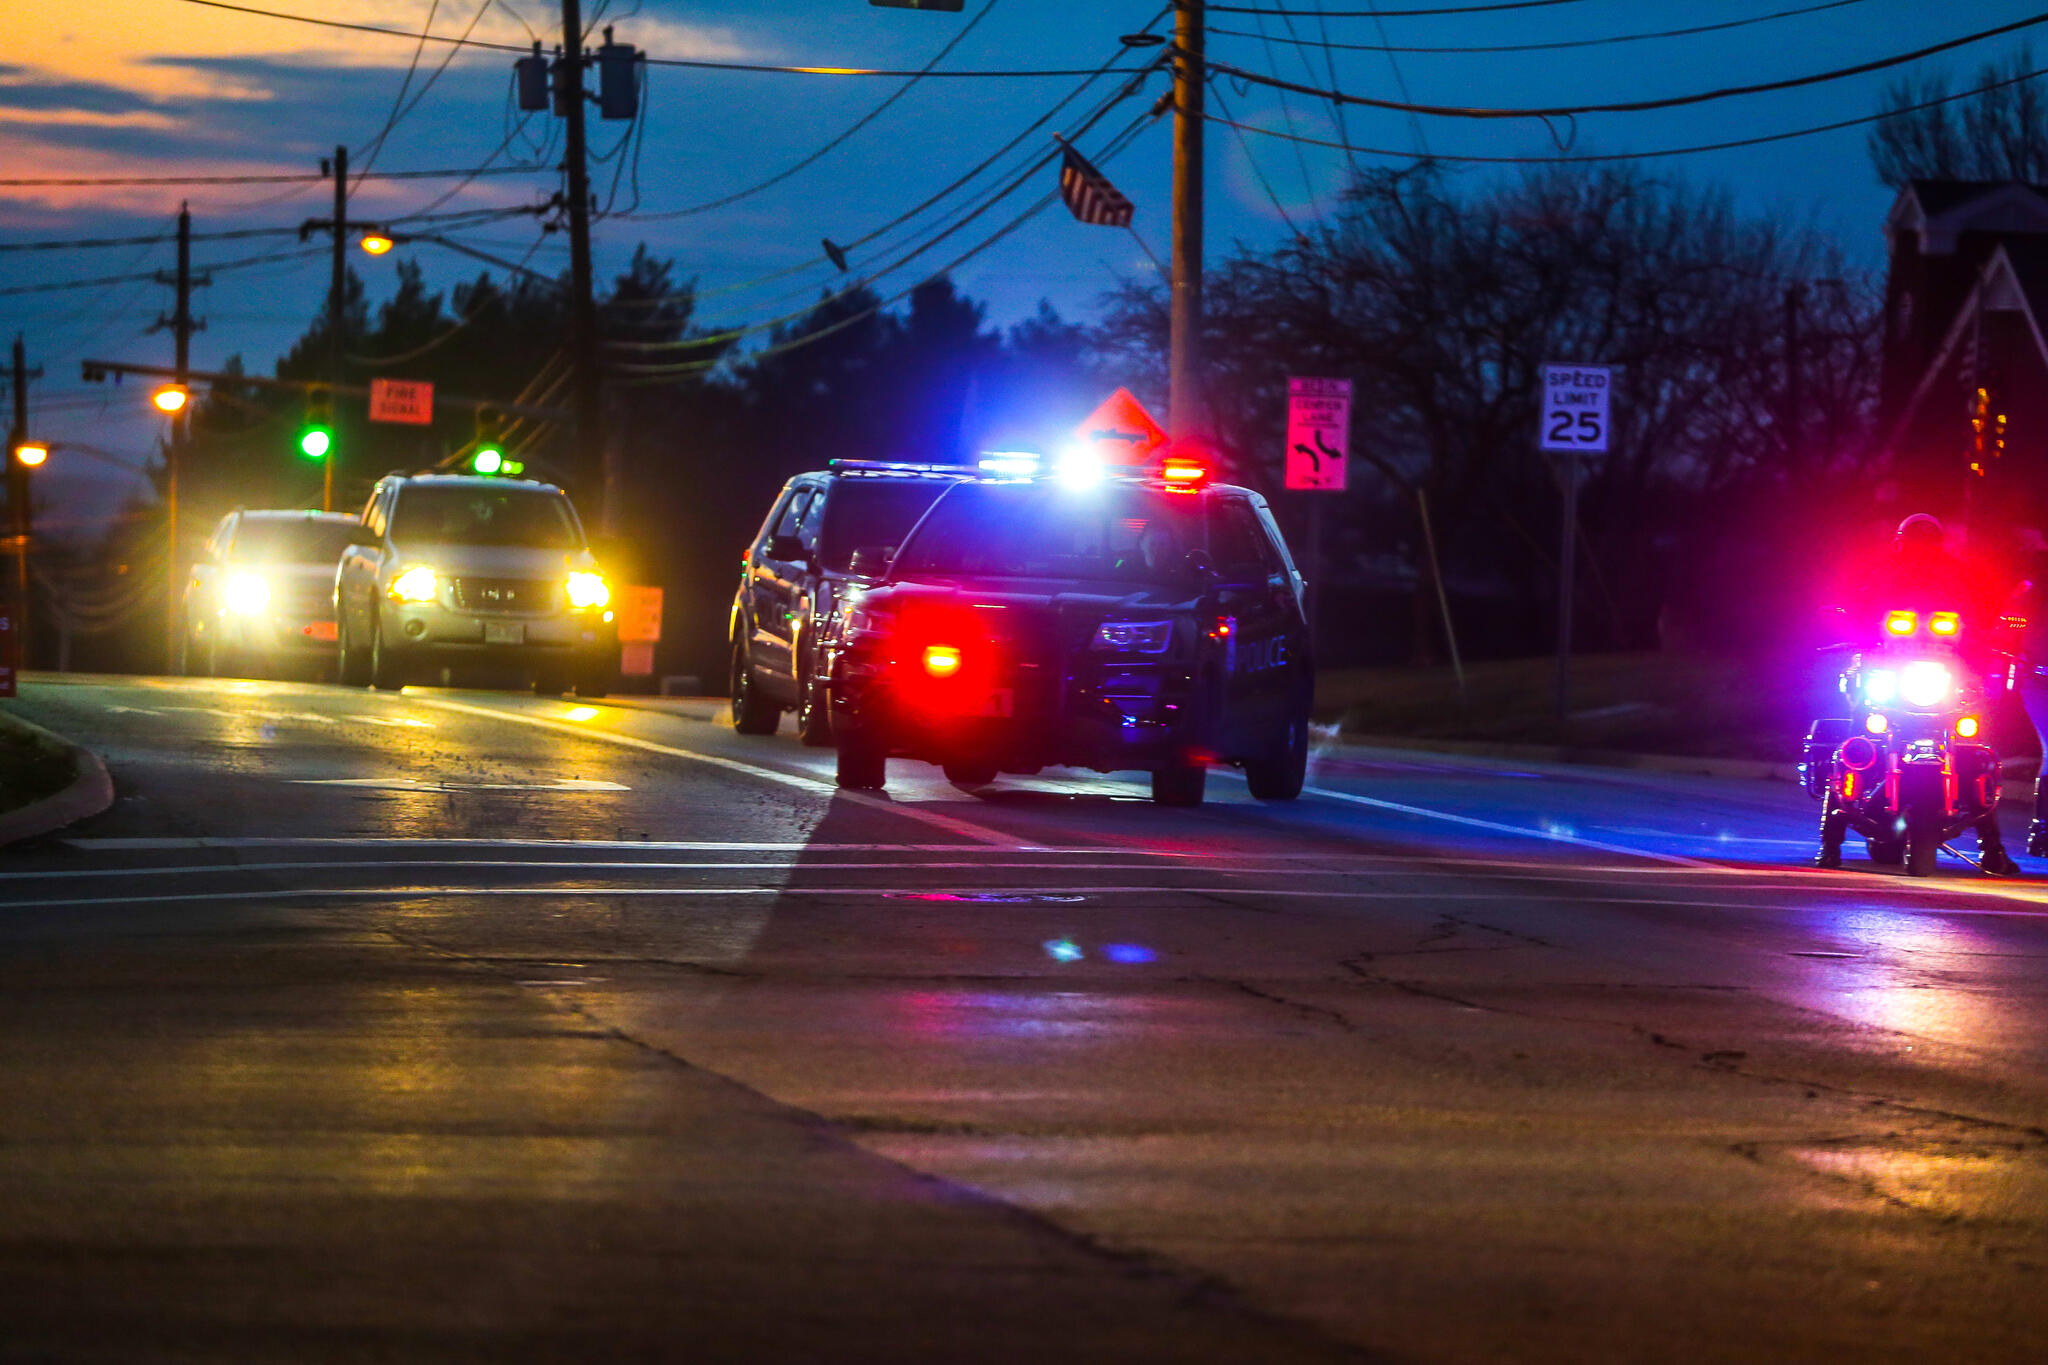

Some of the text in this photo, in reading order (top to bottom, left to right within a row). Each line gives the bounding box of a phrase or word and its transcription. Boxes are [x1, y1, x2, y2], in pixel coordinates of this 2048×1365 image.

[1549, 372, 1606, 386] SPEED
[386, 386, 416, 398] FIRE
[1553, 393, 1599, 405] LIMIT
[1302, 412, 1334, 422] LANE
[1549, 411, 1601, 442] 25
[1238, 635, 1287, 672] POLICE
